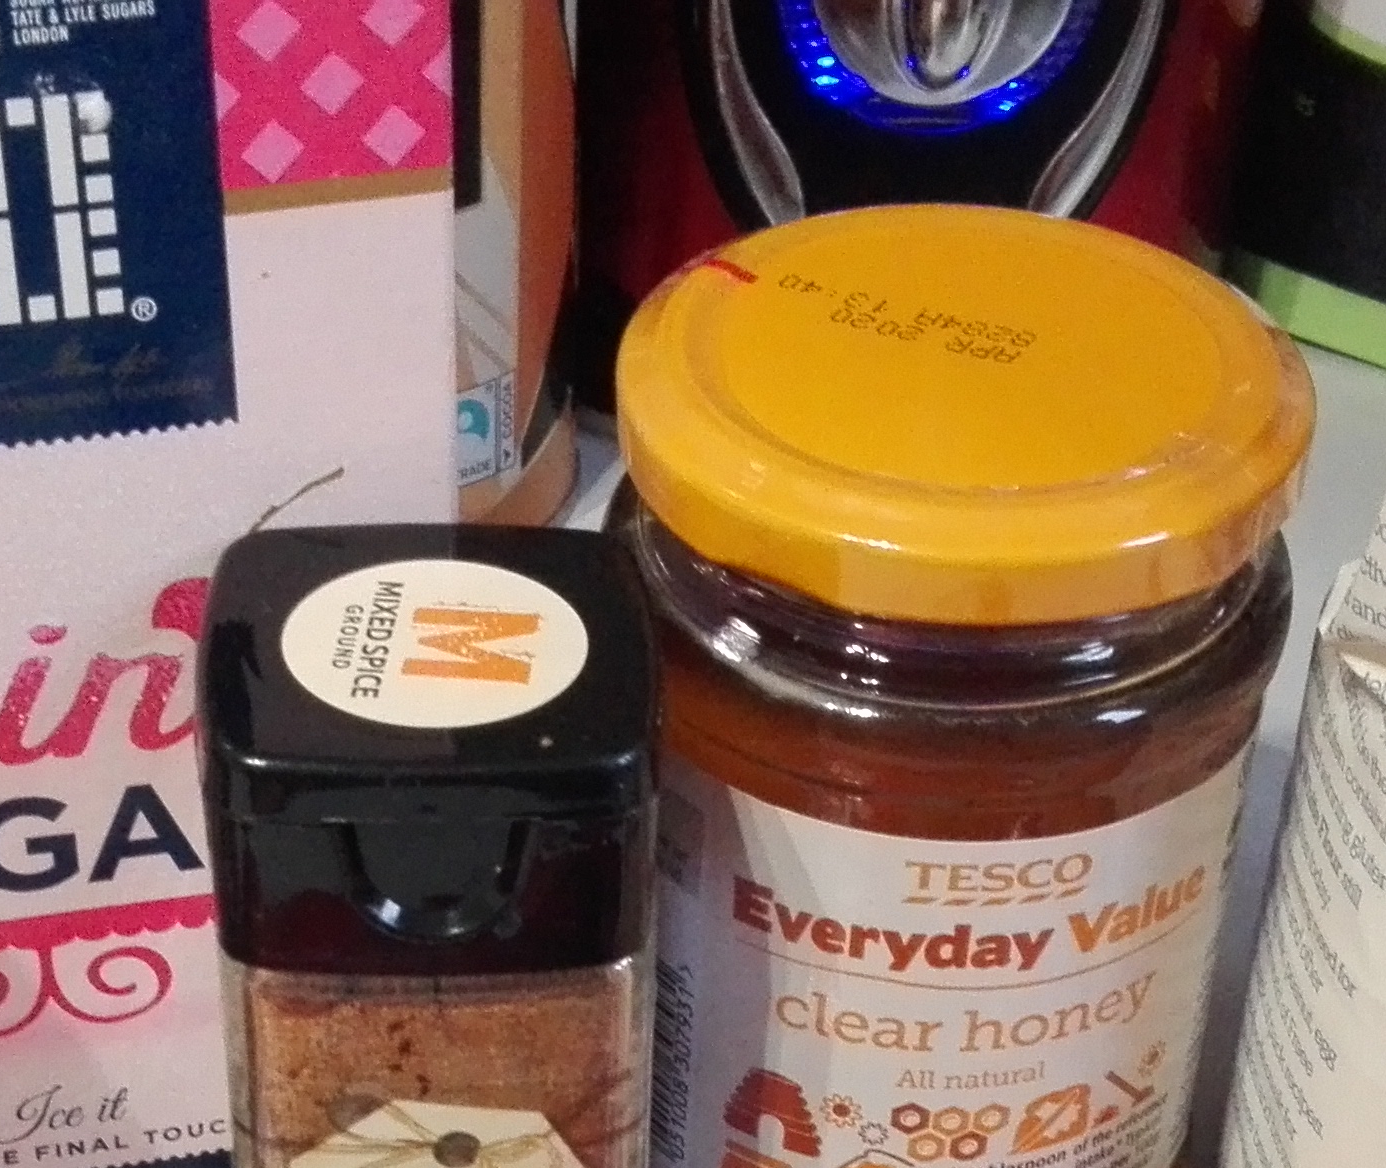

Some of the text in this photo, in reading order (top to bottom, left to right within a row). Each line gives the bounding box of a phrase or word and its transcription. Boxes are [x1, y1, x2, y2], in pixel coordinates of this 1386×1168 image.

[10, 8, 43, 26] TATE
[64, 5, 97, 22] LYLE
[101, 0, 157, 20] SUGARS
[13, 25, 69, 46] LONDON
[829, 308, 924, 341] 2020
[332, 603, 365, 670] GROUND
[350, 580, 405, 700] MIXED SPICE
[400, 606, 545, 685] M
[903, 853, 1095, 894] TESCO
[732, 875, 1054, 972] Everyday
[1069, 865, 1207, 953] Value
[774, 971, 1158, 1055] clear honey
[896, 1062, 1047, 1092] All natural
[97, 1087, 130, 1121] it
[35, 1136, 130, 1160] FINAL
[144, 1118, 228, 1145] TOUC
